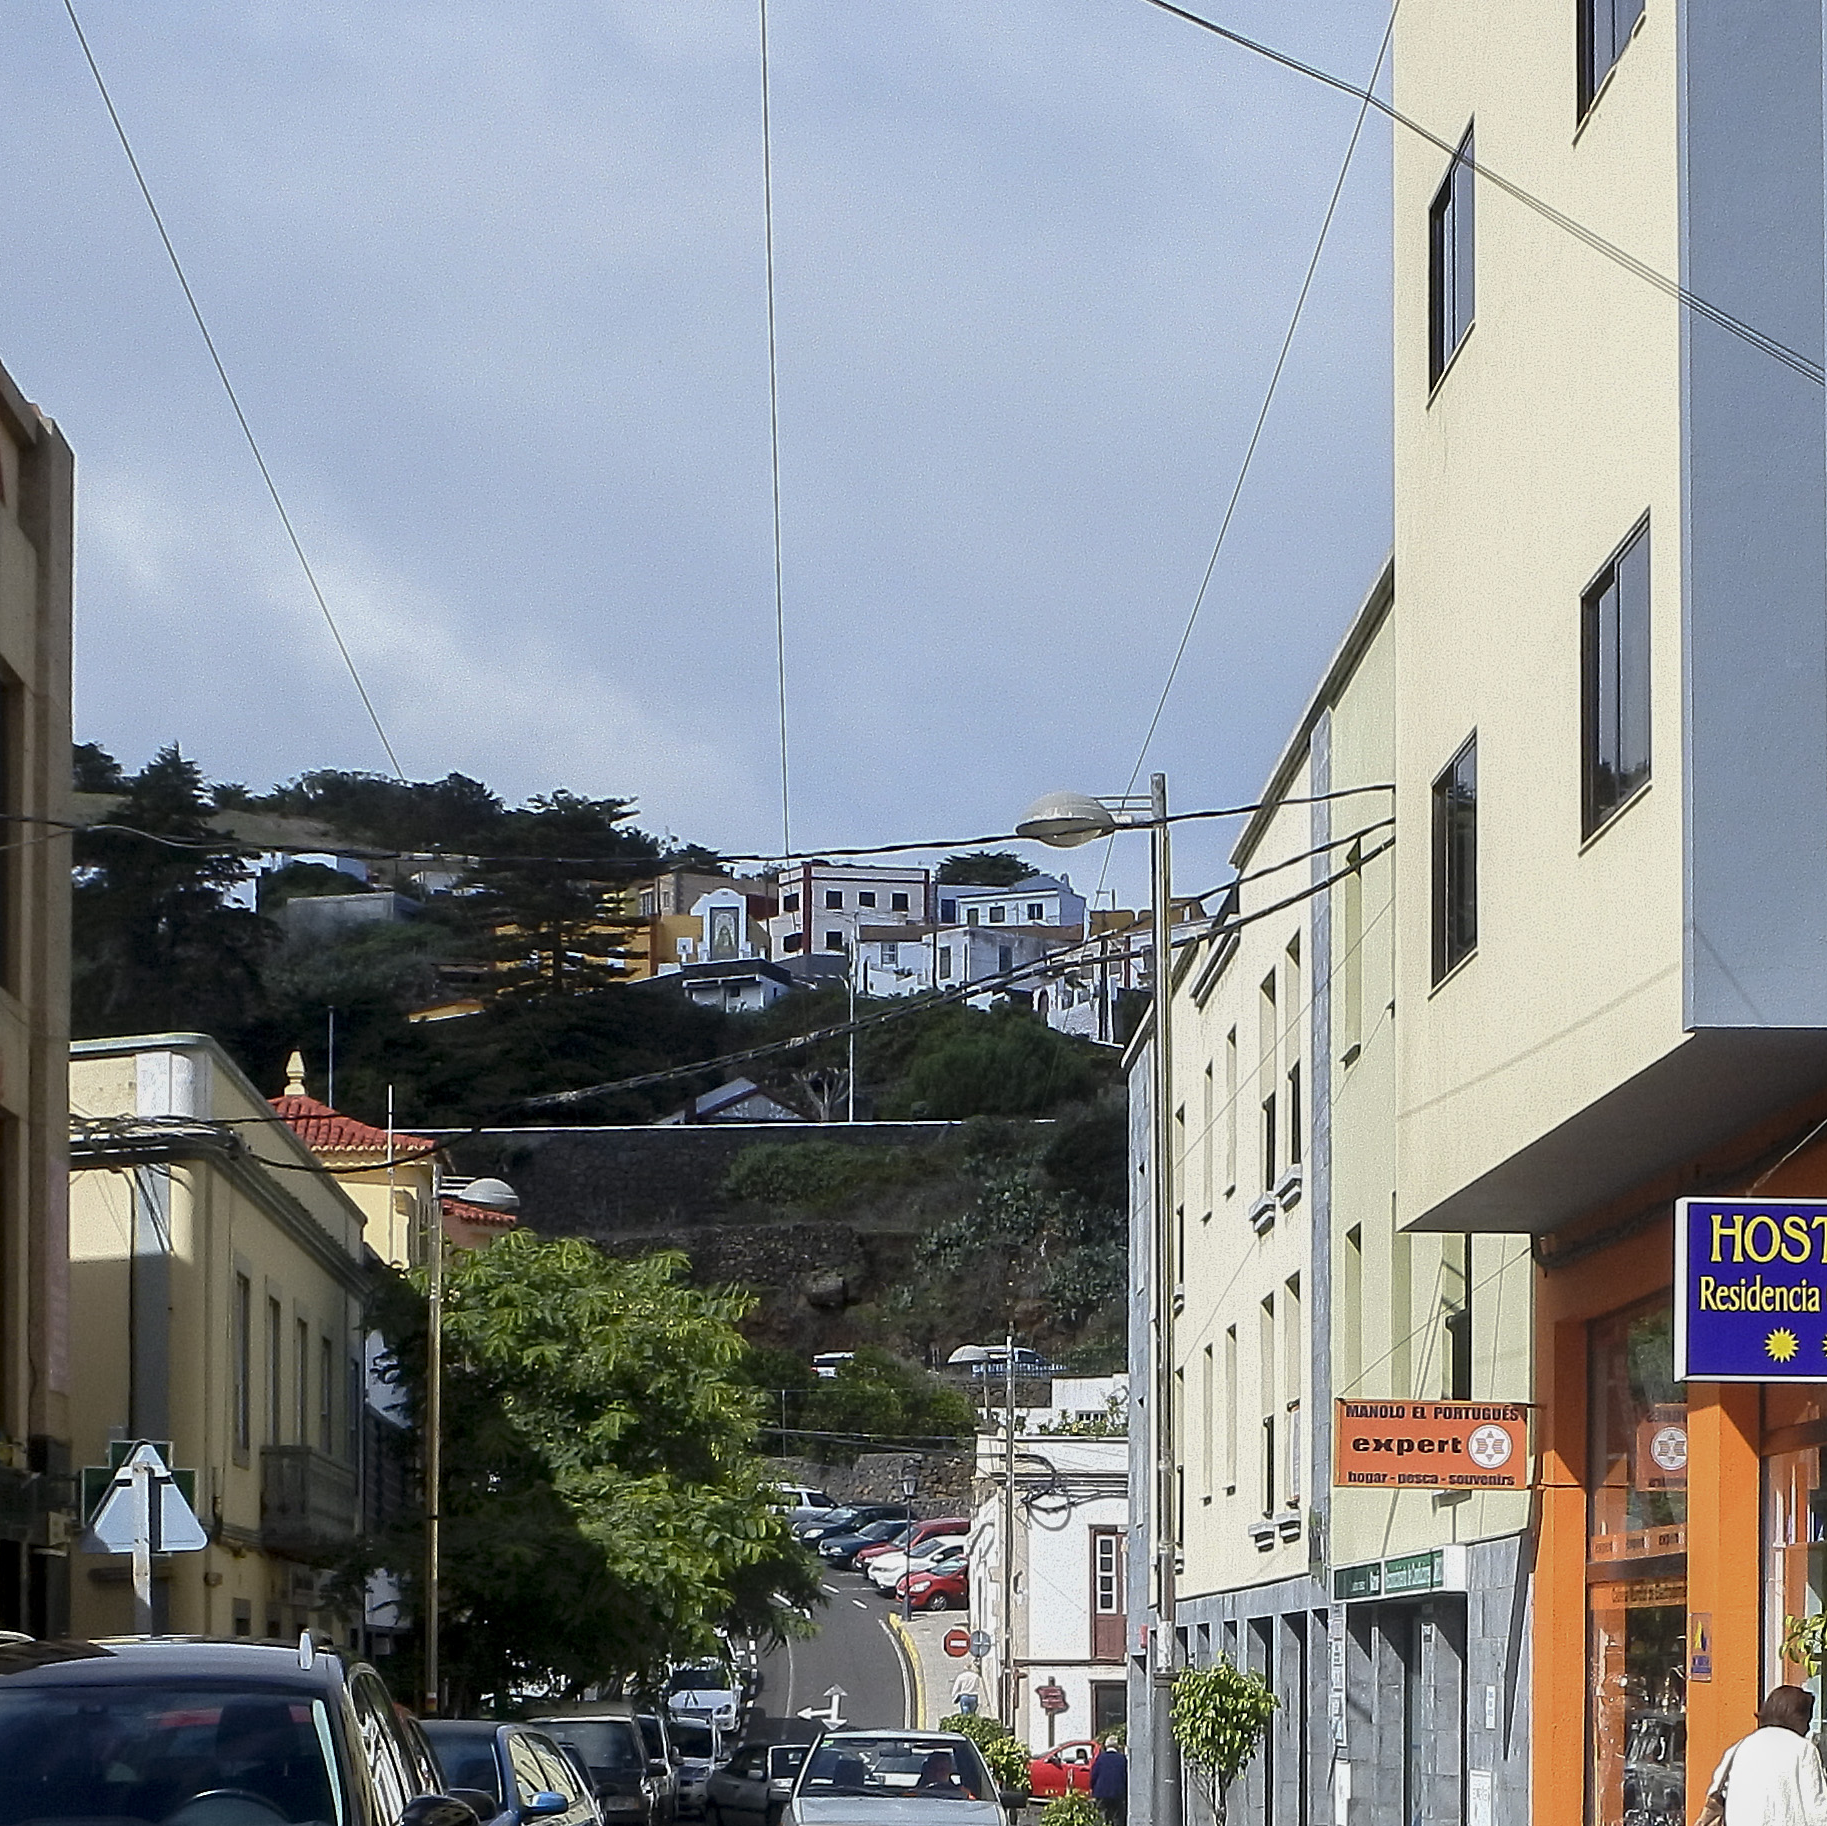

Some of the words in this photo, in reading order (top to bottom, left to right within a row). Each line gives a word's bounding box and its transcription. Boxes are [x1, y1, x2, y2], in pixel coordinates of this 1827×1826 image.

[1700, 1274, 1821, 1312] Residencia
[1345, 1404, 1406, 1420] MANOLO
[1412, 1406, 1427, 1420] EL
[1433, 1404, 1520, 1422] PORTUGUÉS
[1351, 1436, 1463, 1457] expert
[1347, 1470, 1388, 1485] hogar
[1397, 1472, 1439, 1486] pesca
[1448, 1473, 1516, 1487] souvenirs
